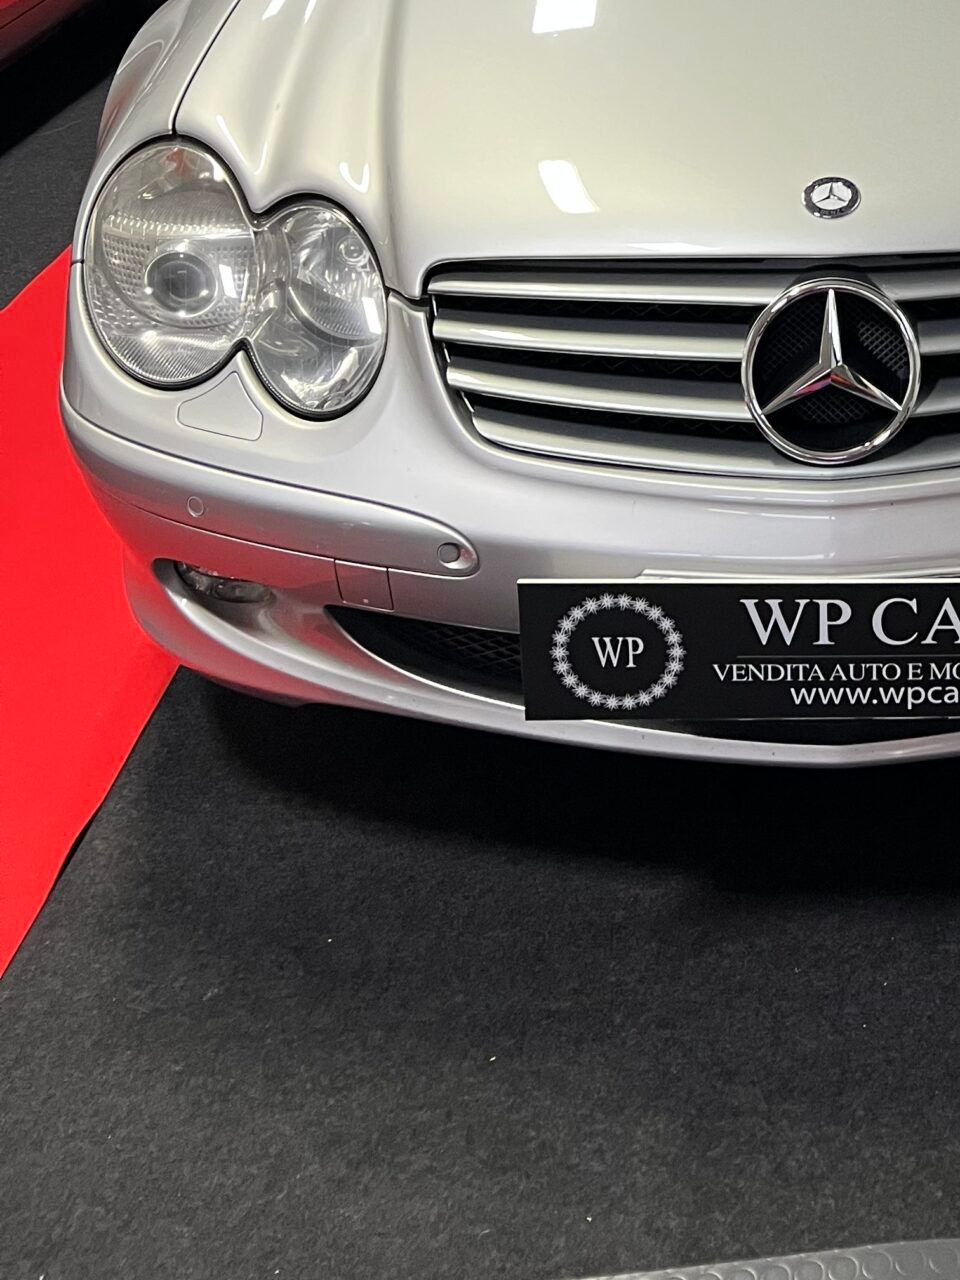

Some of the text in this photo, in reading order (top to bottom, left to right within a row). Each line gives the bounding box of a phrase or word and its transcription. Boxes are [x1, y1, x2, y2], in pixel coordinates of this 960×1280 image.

[739, 599, 852, 646] WP
[591, 636, 644, 668] WP
[713, 663, 825, 681] VENDITA
[829, 663, 901, 681] AUTO
[907, 663, 923, 680] E
